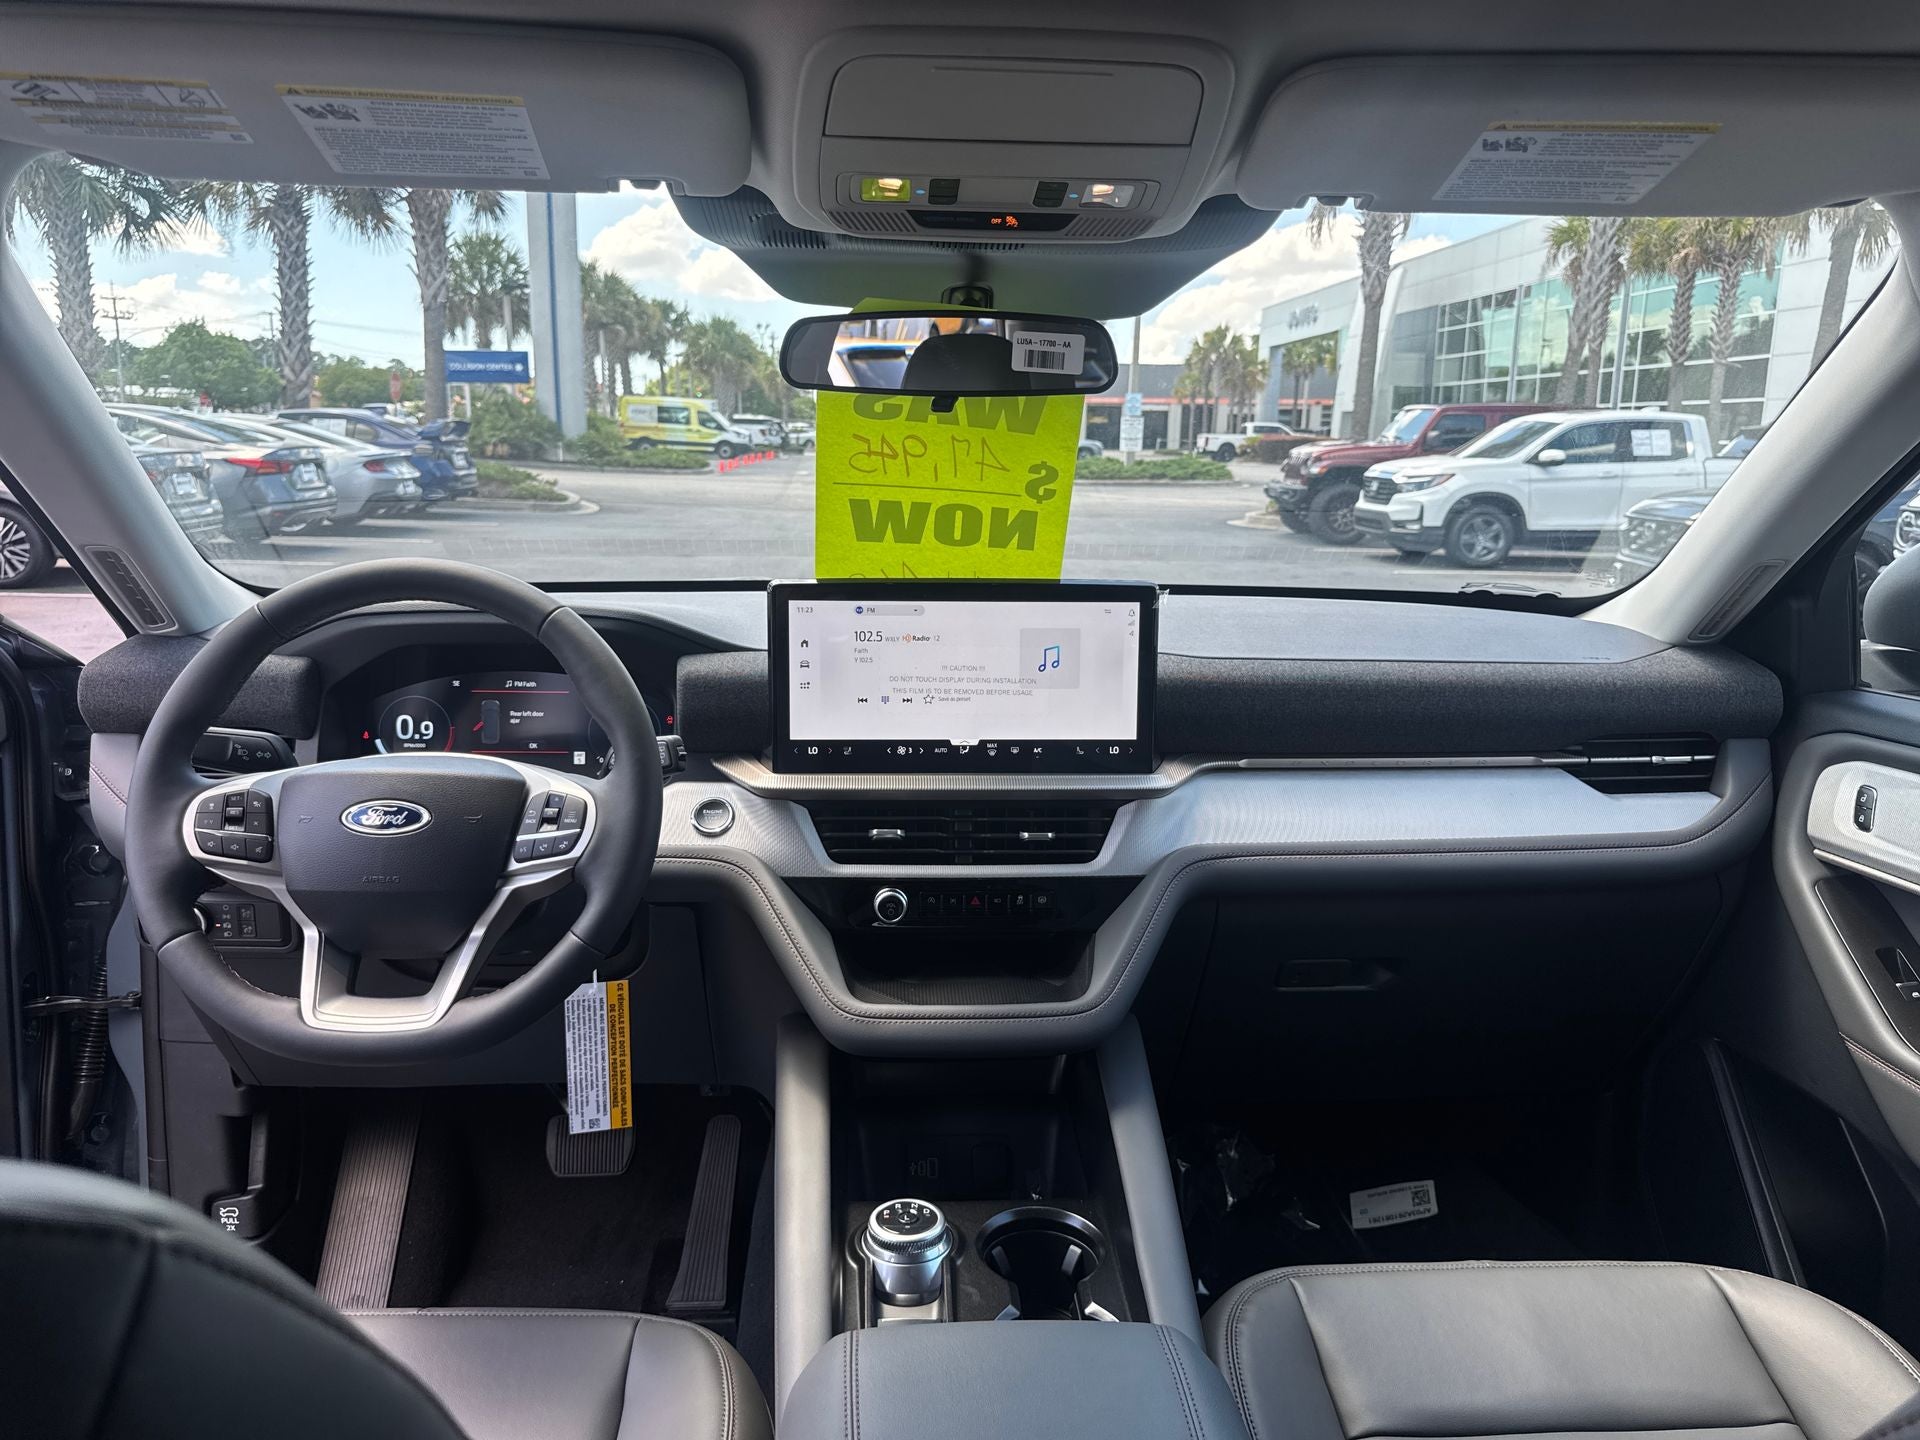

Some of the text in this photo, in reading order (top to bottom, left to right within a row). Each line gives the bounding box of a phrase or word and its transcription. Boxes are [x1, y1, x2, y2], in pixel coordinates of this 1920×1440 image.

[854, 631, 883, 642] 102.5
[396, 714, 434, 740] 0.9
[808, 747, 818, 755] LO
[359, 806, 406, 827] Ford
[617, 982, 623, 991] CE
[609, 1003, 615, 1013] DE
[617, 993, 625, 1024] VÉHICULE
[619, 1059, 625, 1067] DE
